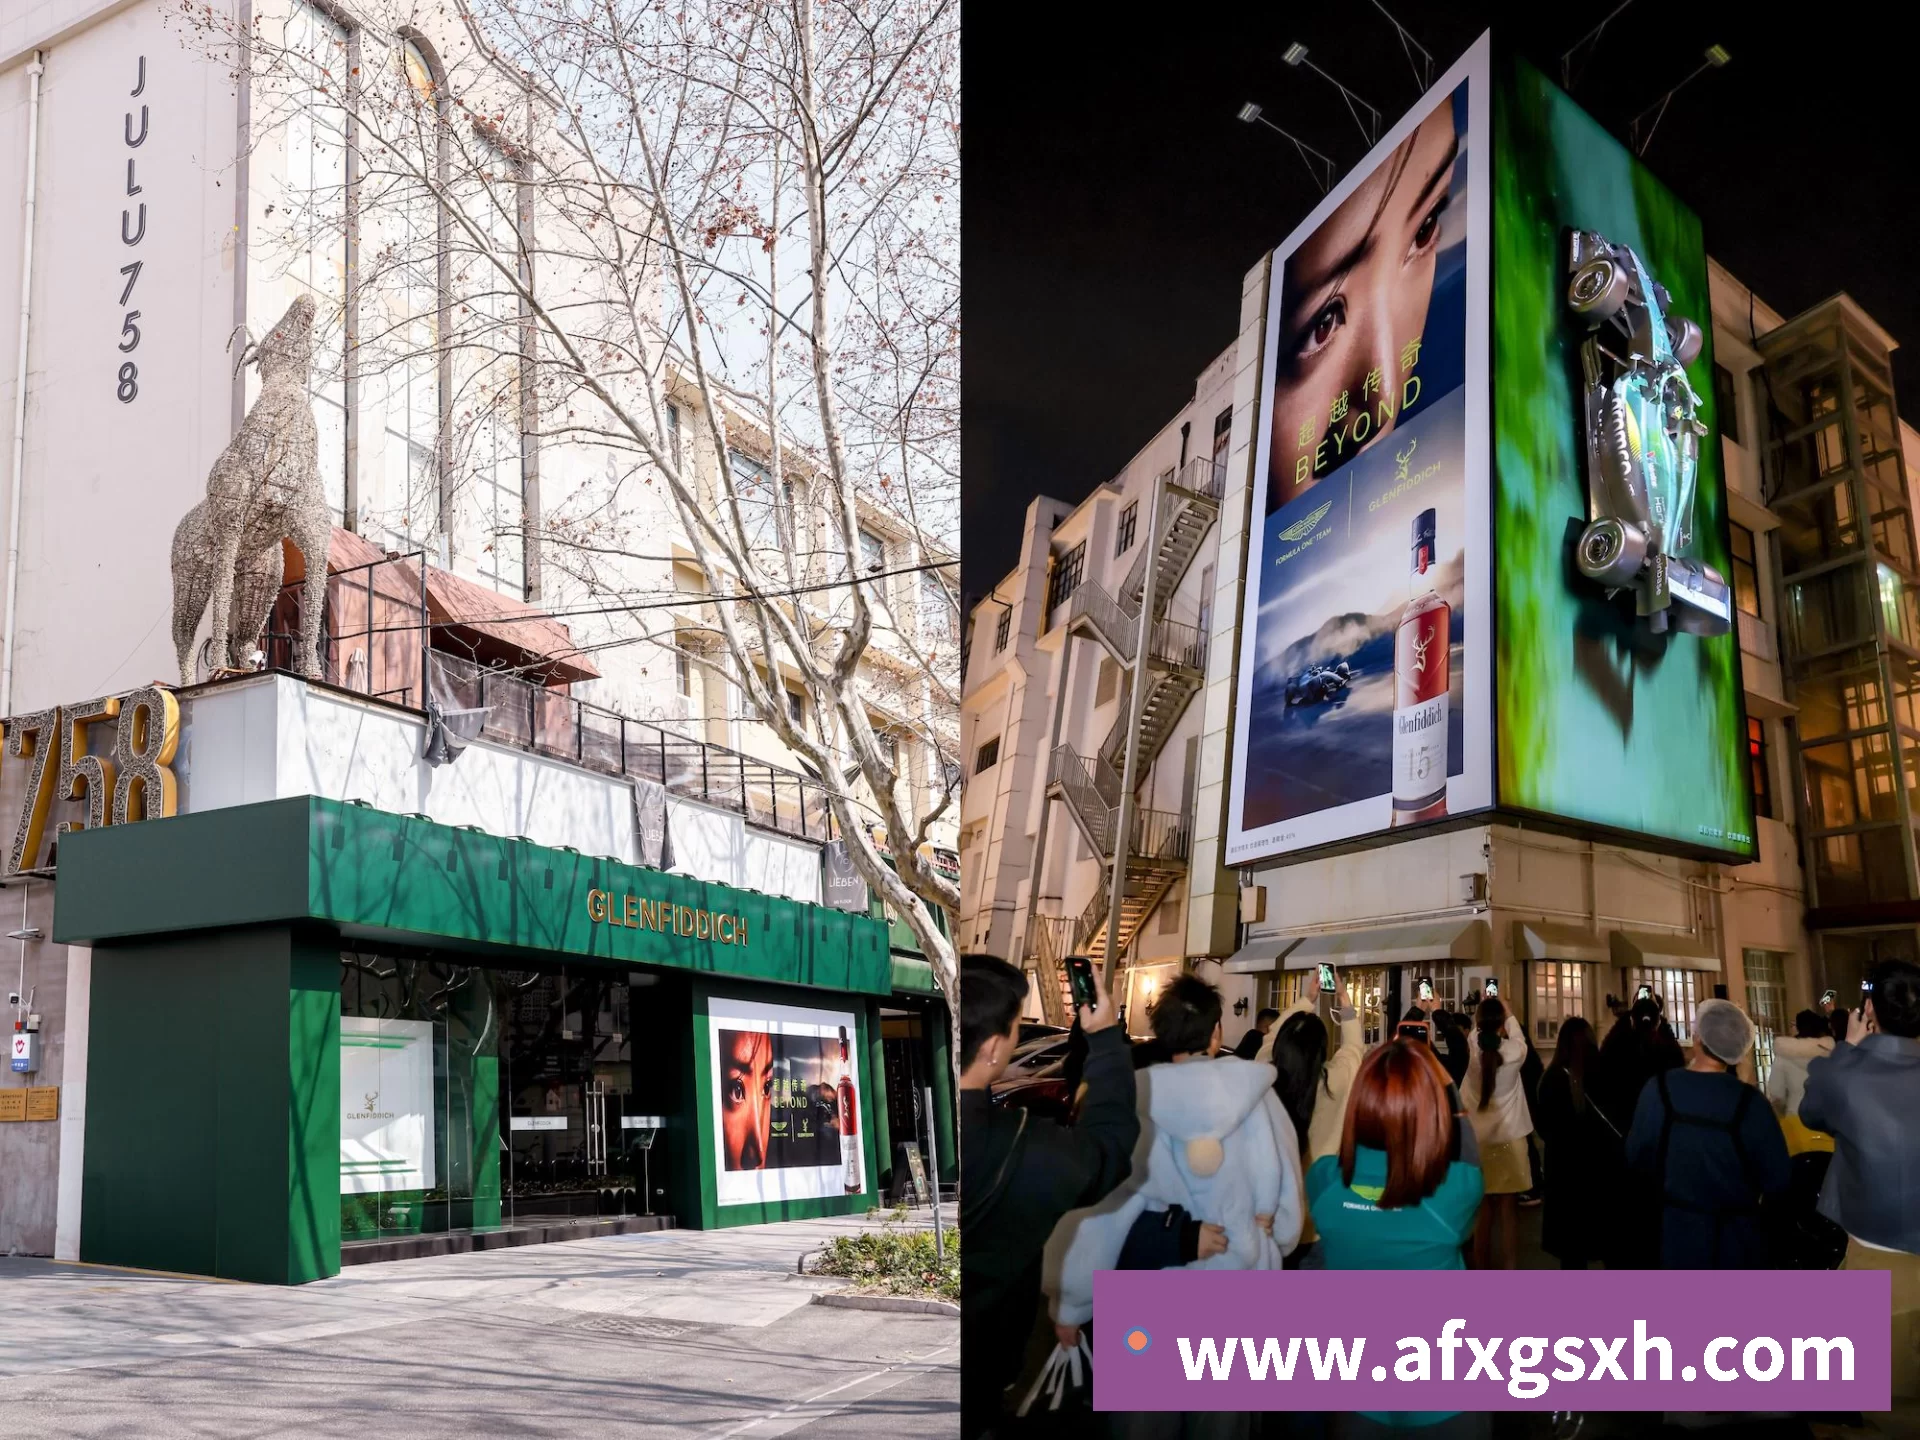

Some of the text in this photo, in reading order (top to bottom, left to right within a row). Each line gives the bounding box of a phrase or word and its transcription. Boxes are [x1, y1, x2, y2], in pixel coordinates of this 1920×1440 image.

[1298, 337, 1421, 451] 超越传奇
[1295, 375, 1421, 485] BEYOND
[1368, 461, 1441, 512] GLENFIDDICH
[1276, 546, 1300, 566] FORMULA
[1316, 526, 1332, 541] TEAM
[1655, 555, 1664, 596] oinbase
[1408, 746, 1431, 781] 15
[588, 889, 748, 946] GLENFIDDICH
[774, 1096, 808, 1108] BEYOND
